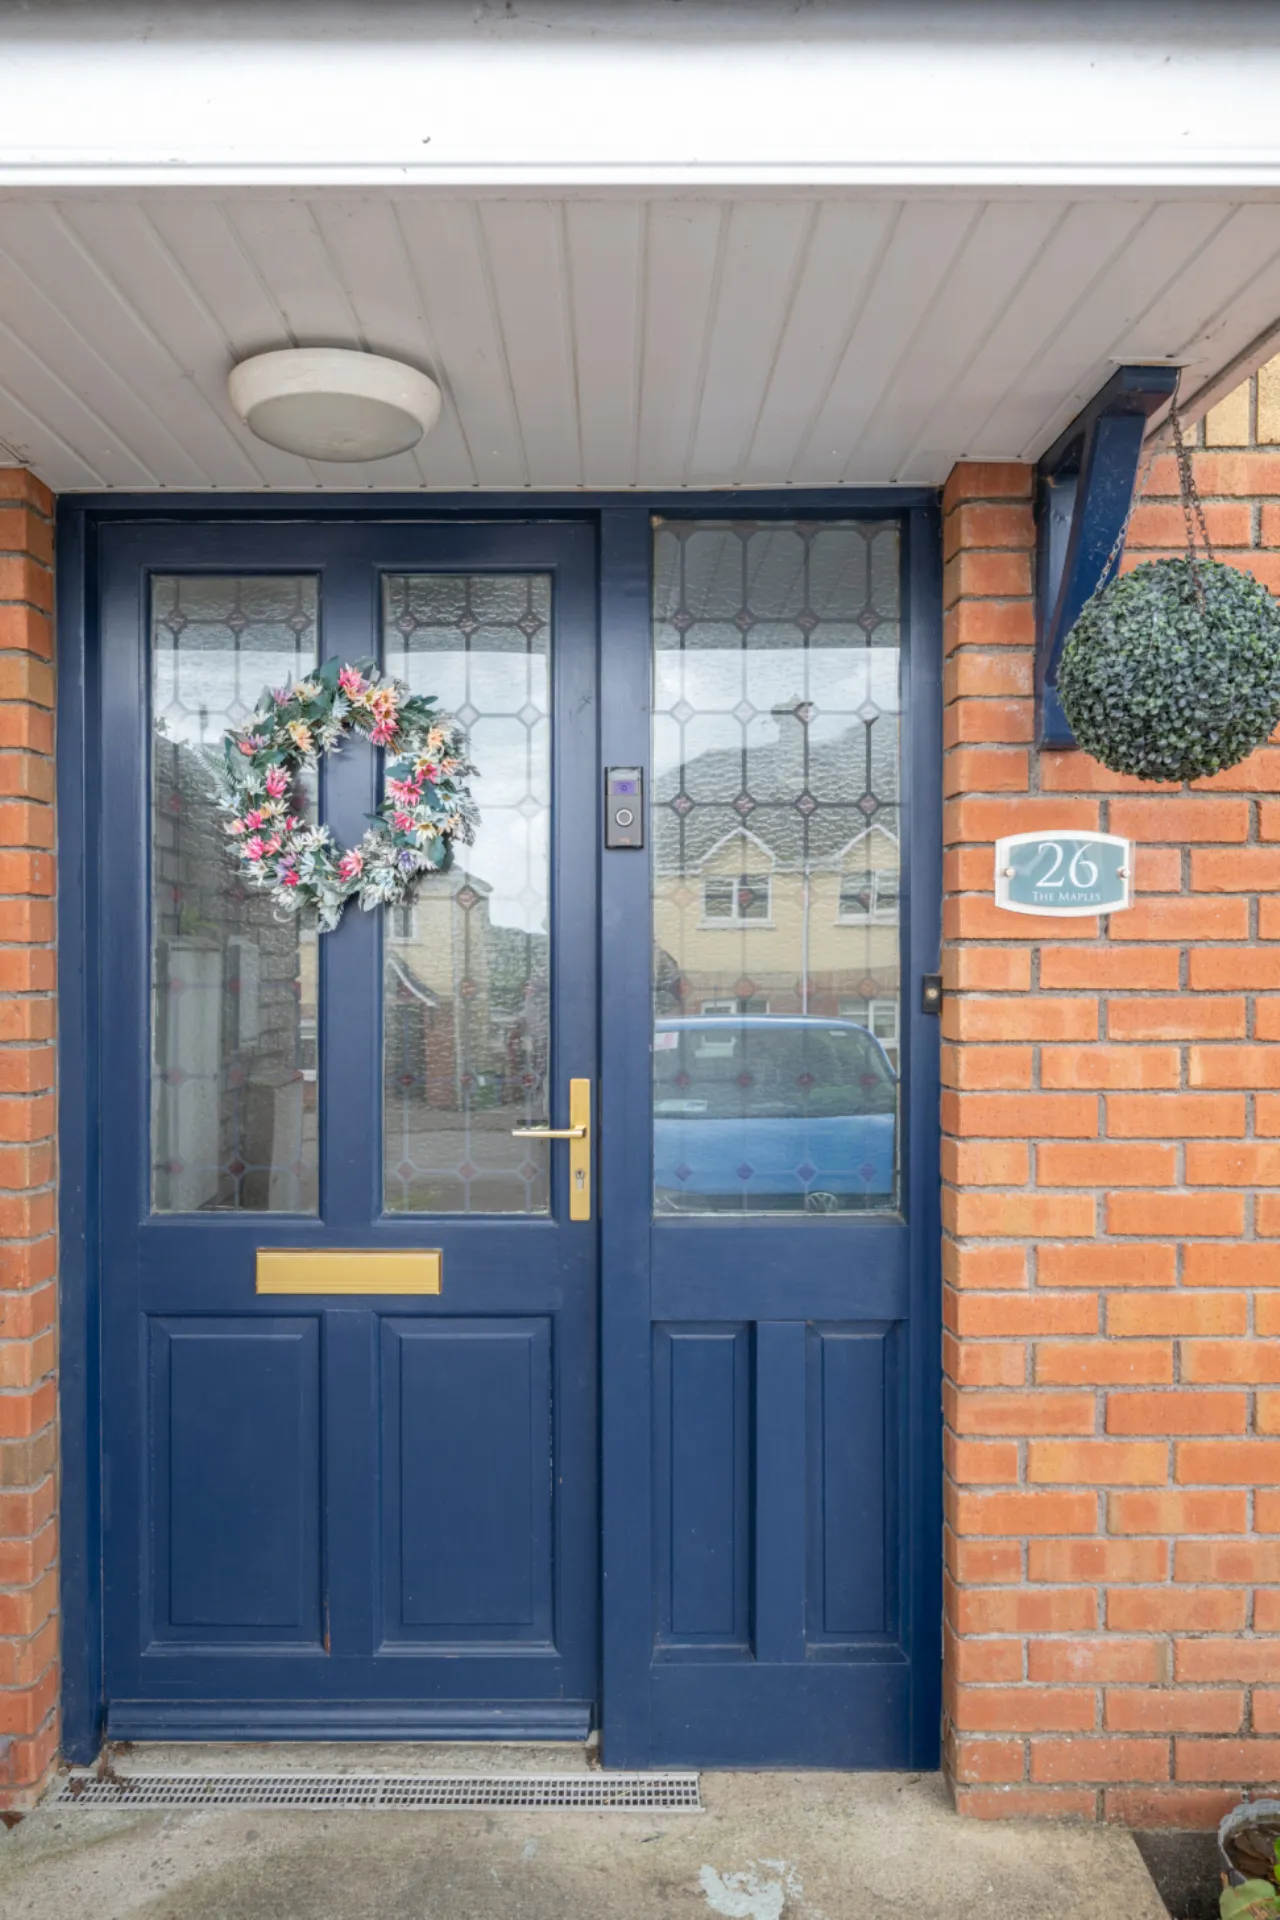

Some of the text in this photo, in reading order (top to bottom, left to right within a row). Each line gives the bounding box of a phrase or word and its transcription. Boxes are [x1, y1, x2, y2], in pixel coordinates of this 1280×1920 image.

[1035, 842, 1099, 888] 26
[1032, 891, 1102, 901] THE MAPLES
